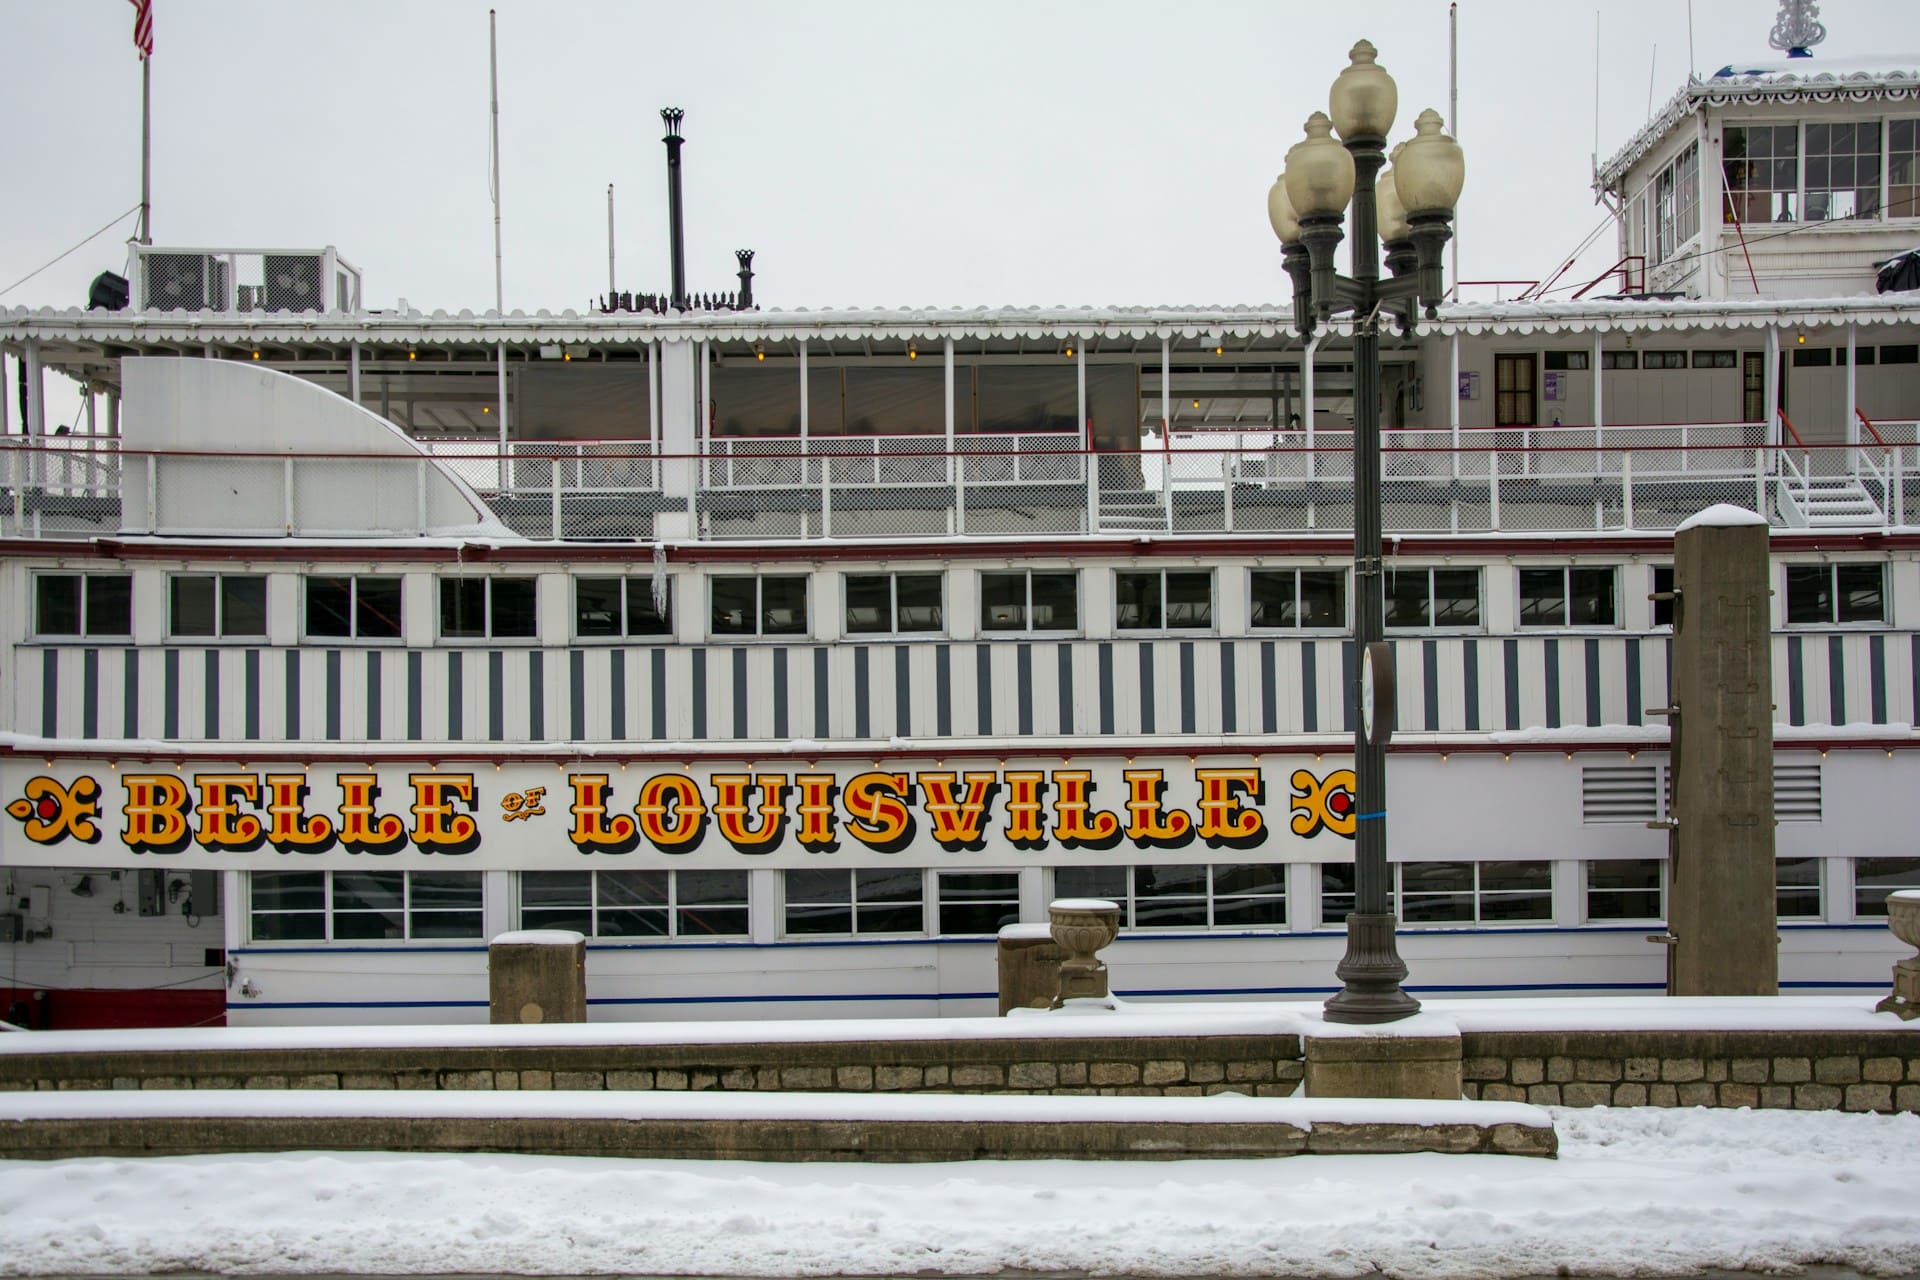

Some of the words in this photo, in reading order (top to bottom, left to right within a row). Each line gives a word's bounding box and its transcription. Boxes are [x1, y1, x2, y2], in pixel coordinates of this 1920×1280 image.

[121, 773, 481, 854] BELLE
[501, 786, 546, 812] OF
[568, 768, 1269, 854] LOUISVILLE
